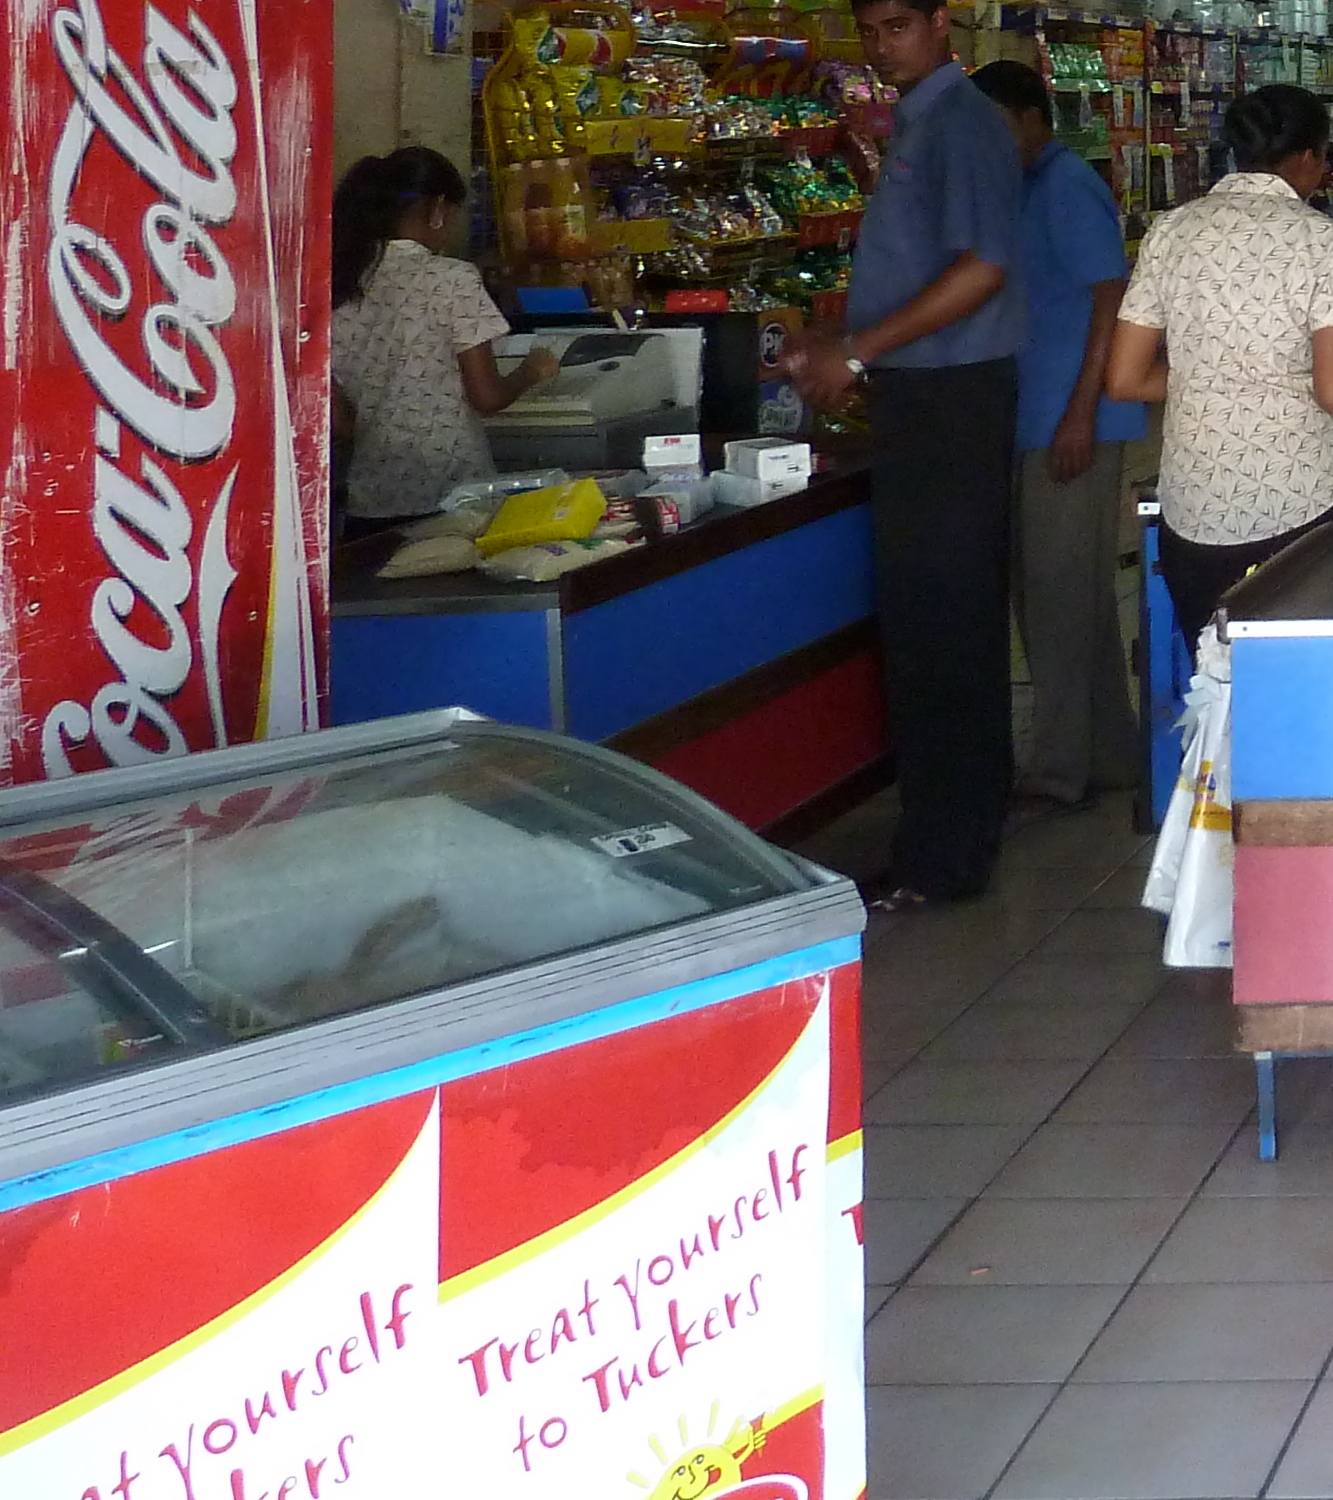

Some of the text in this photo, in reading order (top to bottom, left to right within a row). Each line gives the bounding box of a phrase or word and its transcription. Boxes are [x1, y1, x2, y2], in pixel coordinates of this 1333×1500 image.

[458, 1143, 810, 1398] Treat yourself
[514, 1272, 764, 1473] to Tuckers
[159, 1283, 415, 1492] yourself
